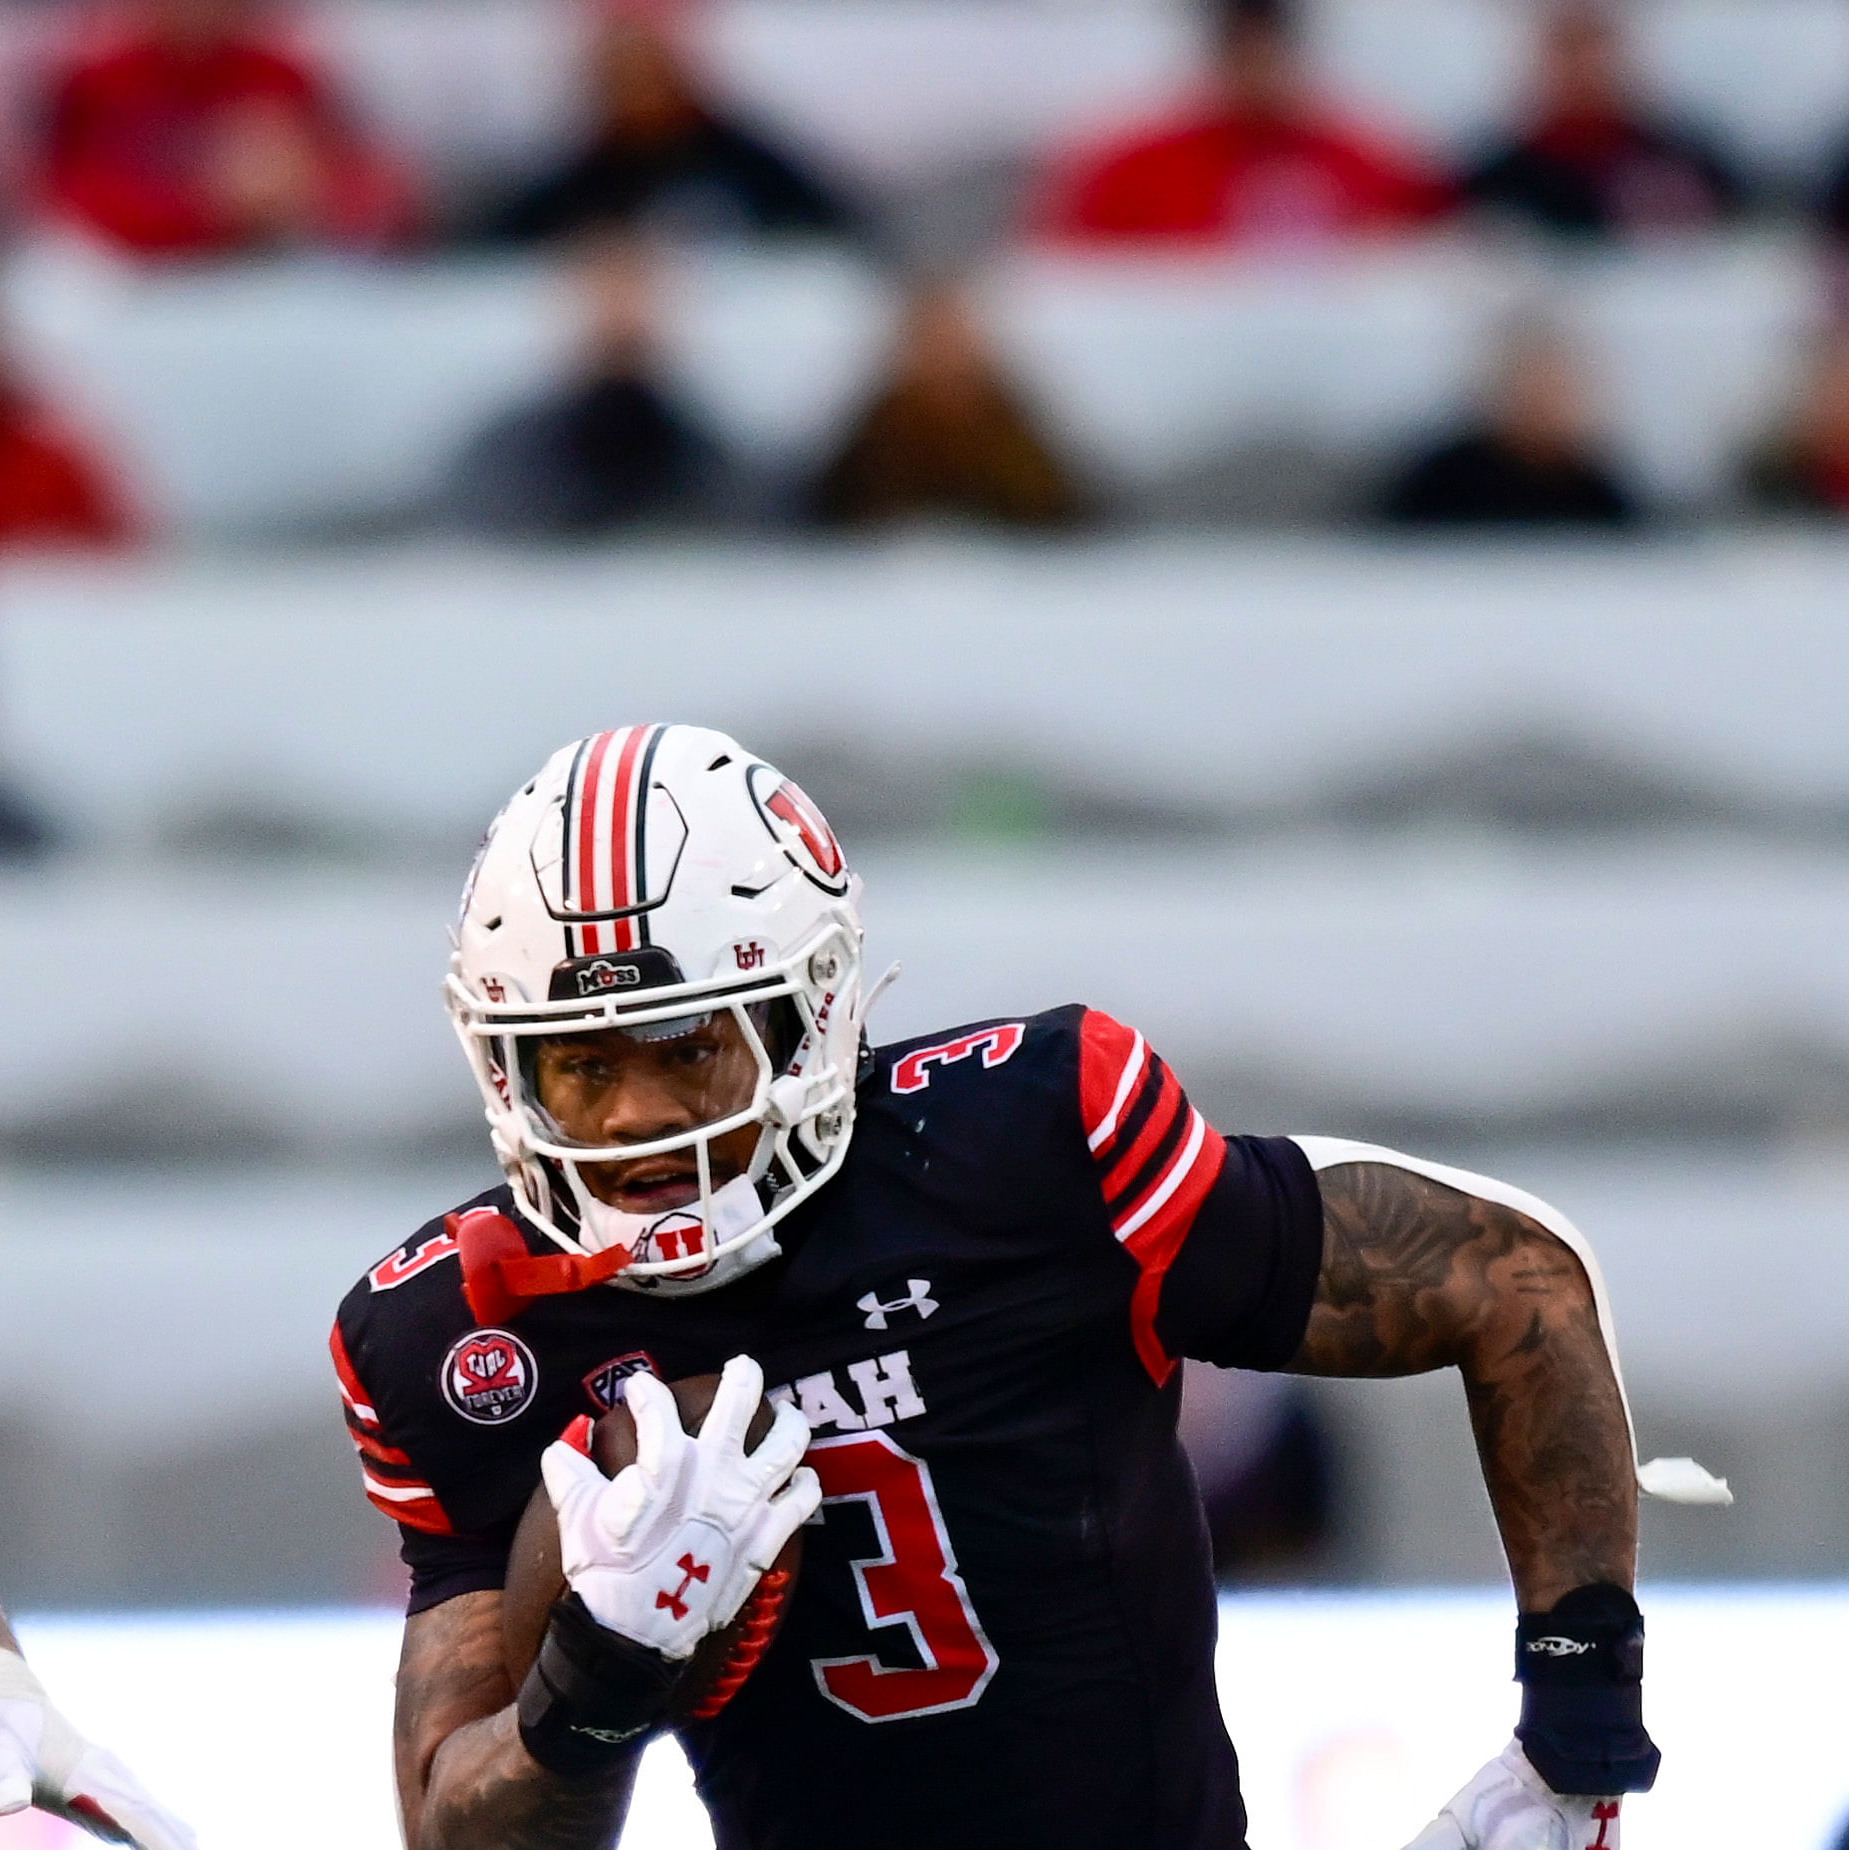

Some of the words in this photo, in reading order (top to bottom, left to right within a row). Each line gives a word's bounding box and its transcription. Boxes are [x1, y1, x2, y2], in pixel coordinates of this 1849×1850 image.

[764, 779, 842, 879] U
[890, 1022, 1026, 1094] 3
[810, 1428, 1001, 1725] 3
